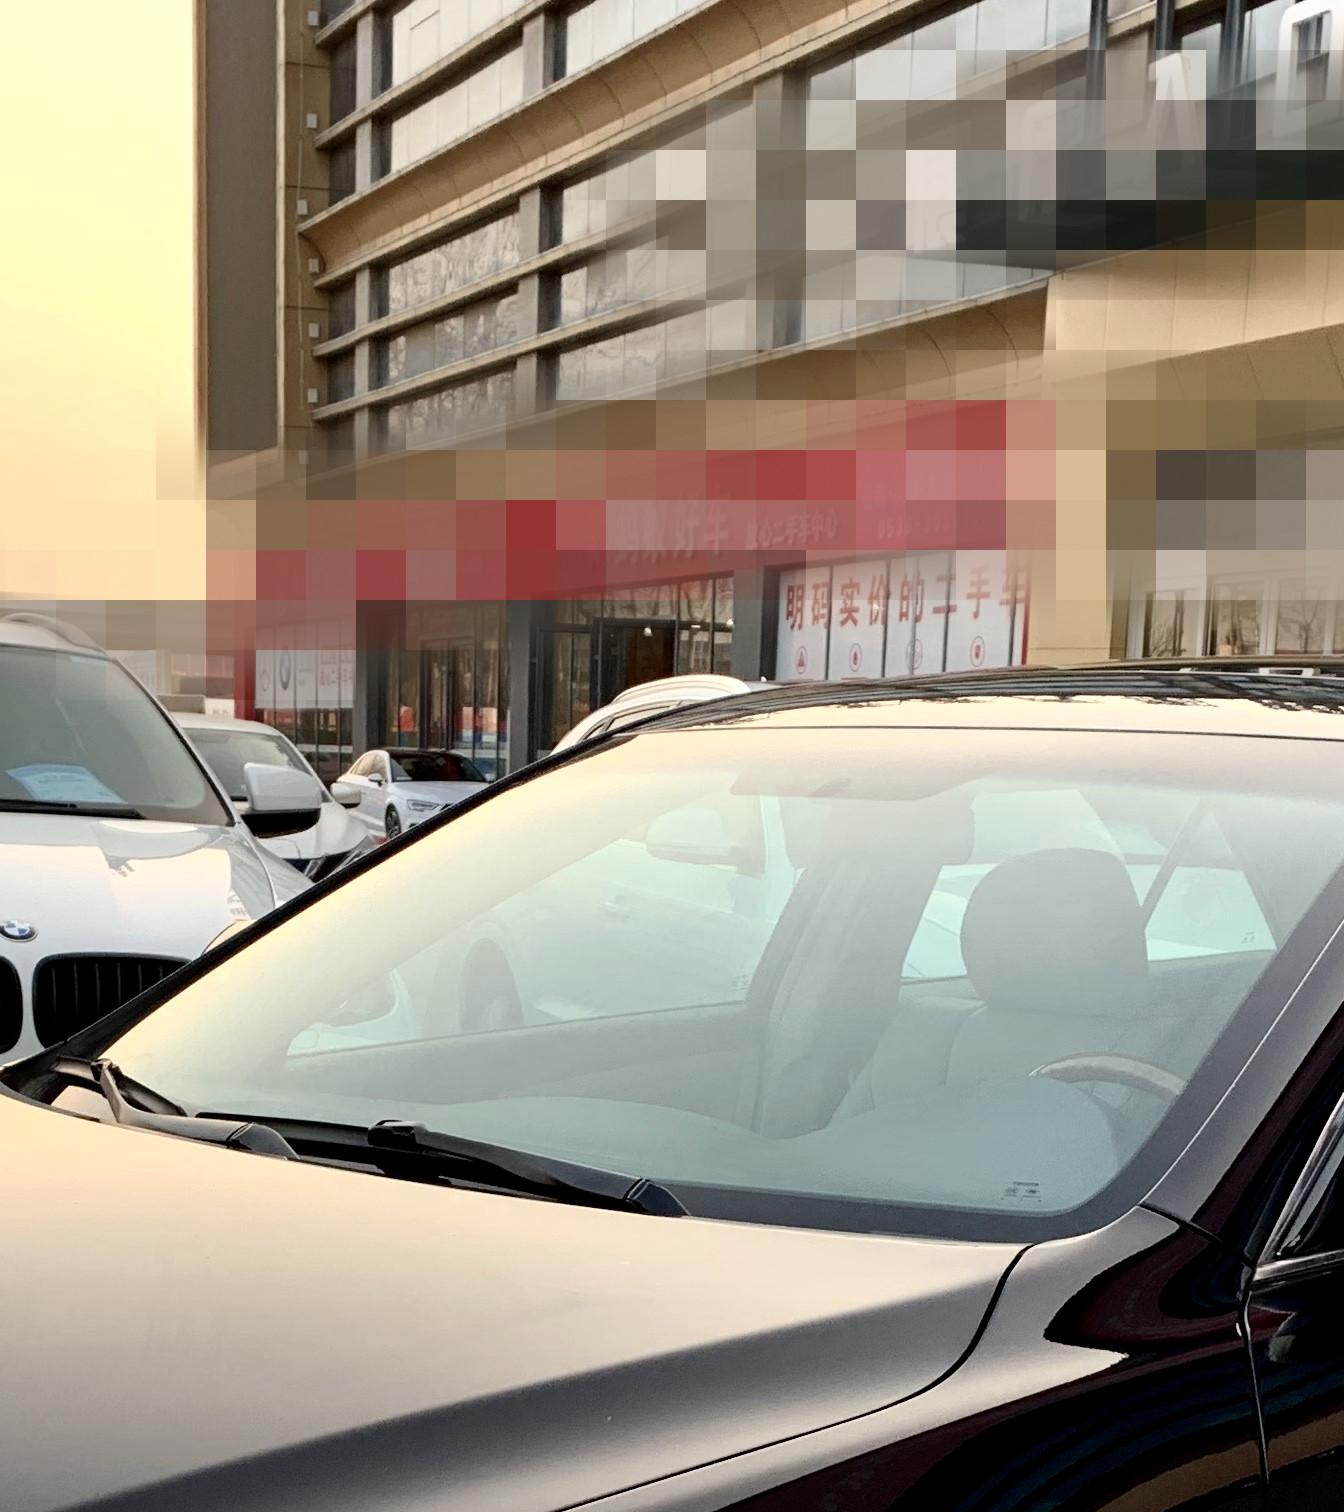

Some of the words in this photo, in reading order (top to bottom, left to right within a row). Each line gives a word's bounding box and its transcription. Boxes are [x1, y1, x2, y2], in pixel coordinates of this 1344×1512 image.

[786, 563, 1026, 631] 明码实价的二手车
